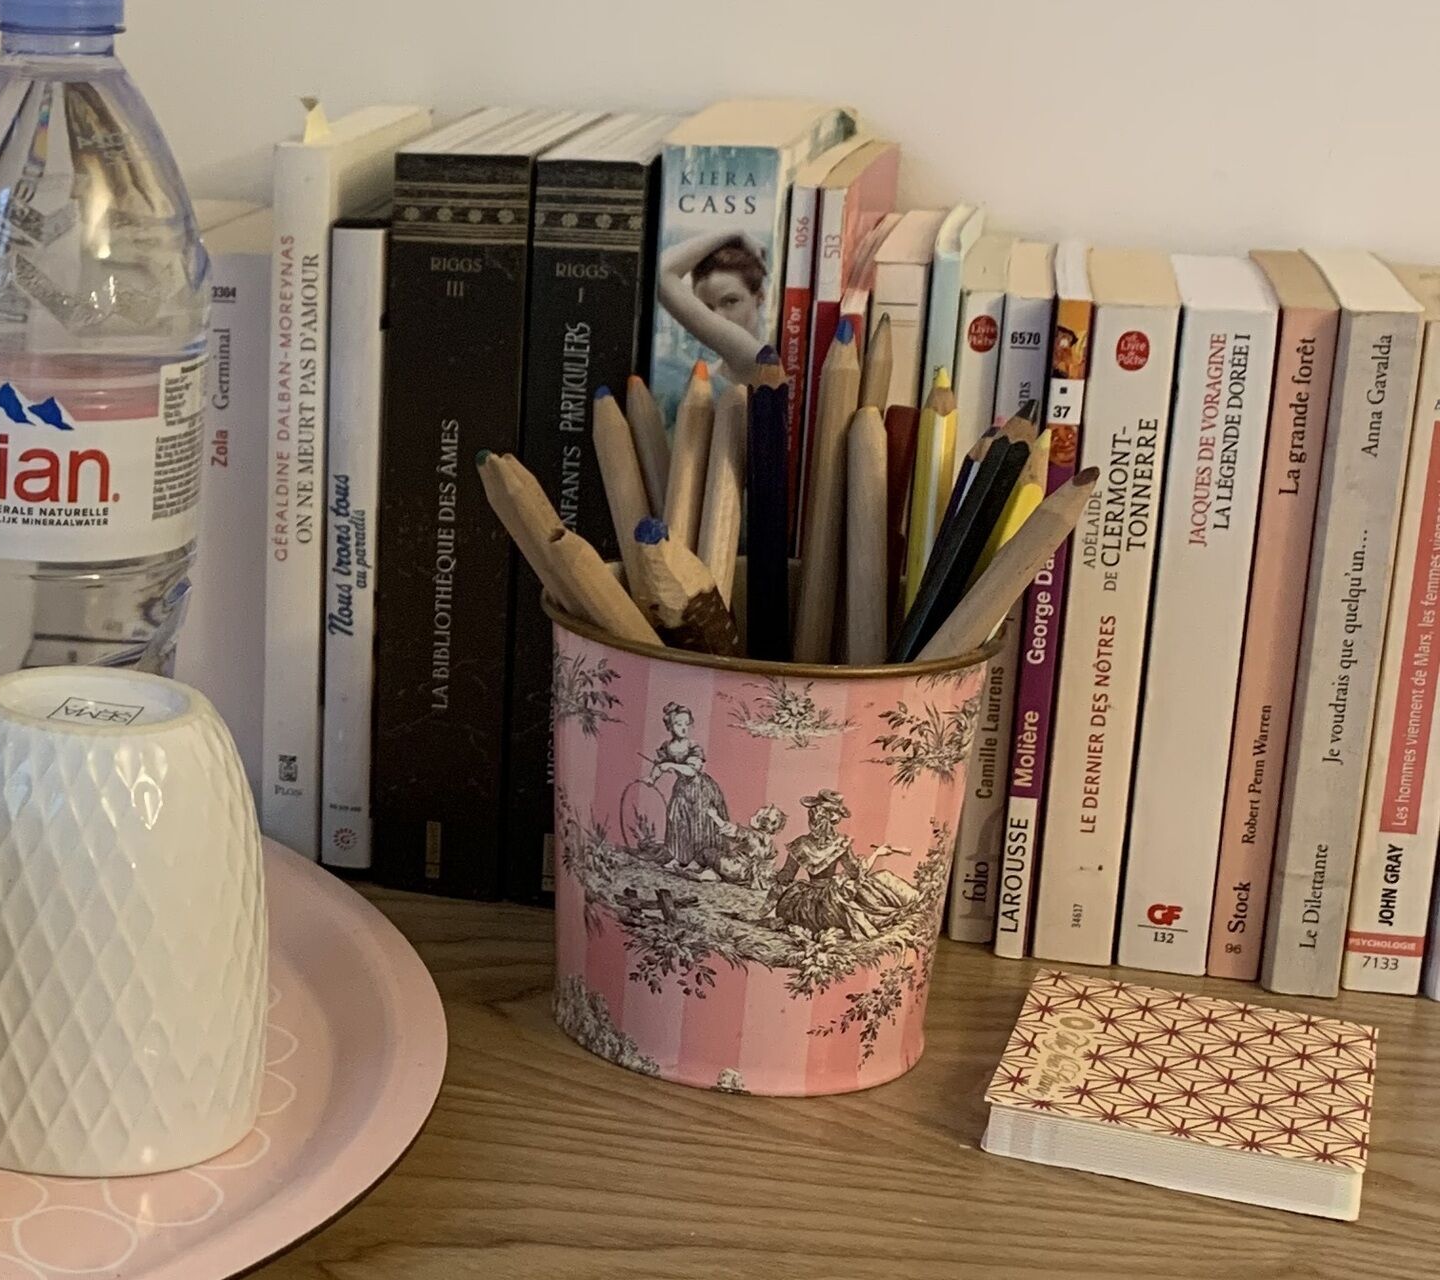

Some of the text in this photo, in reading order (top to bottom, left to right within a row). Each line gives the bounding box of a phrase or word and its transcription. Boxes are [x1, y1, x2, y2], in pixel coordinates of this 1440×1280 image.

[678, 194, 756, 214] CASS
[681, 171, 756, 187] KIERA
[795, 216, 810, 249] 1056
[824, 234, 841, 259] 513
[430, 256, 483, 273] RIGGS
[446, 280, 465, 297] III
[555, 262, 609, 279] RIGGS
[786, 306, 802, 334] d'or
[1010, 331, 1041, 345] 6570
[786, 337, 800, 371] yeux
[1227, 344, 1250, 410] DORÉE
[211, 327, 231, 468] Zola Germinal
[272, 234, 295, 562] GÉRALDINE DALBAN-MOREYNAS
[296, 253, 320, 544] ON NE MEURT PAS D'AMOUR
[1053, 406, 1071, 419] 37
[1278, 338, 1317, 496] La grande forêt
[1361, 334, 1393, 458] Anna Gavalda
[560, 321, 591, 533] NFANTS PARTICULIERS
[1188, 333, 1228, 548] JACQUES DE VORAGINE
[1214, 413, 1242, 502] LÉGENDE
[1101, 425, 1132, 592] DE CLERMONT-
[1125, 418, 1159, 552] TONNERRE
[21, 517, 109, 527] MINERAALWATER
[39, 506, 109, 517] NATURELLE
[1213, 506, 1232, 531] LA
[328, 473, 354, 637] Nous irons tous
[351, 509, 373, 589] au paradis
[431, 418, 460, 710] LA BIBLIOTHÈQUE DES ÂMES
[1420, 554, 1440, 606] femmes
[1026, 590, 1055, 665] George
[1417, 609, 1436, 628] les
[1340, 638, 1358, 670] que
[1414, 631, 1434, 668] Mars,
[1411, 670, 1428, 687] de
[975, 665, 1005, 801] Camille Laurens
[1080, 615, 1117, 834] LE DERNIER DES NÔTRES
[1329, 673, 1350, 744] voudrais
[1404, 688, 1426, 750] viennent
[1013, 710, 1040, 788] Molière
[1241, 704, 1272, 846] Robert Penn Warren
[1322, 748, 1344, 766] Je
[1395, 749, 1417, 804] hommes
[1392, 806, 1410, 827] Les
[962, 861, 990, 903] folio
[1000, 818, 1029, 933] LAROUSSE
[1299, 843, 1329, 950] Le Dilettante
[1378, 843, 1404, 927] JOHN GRAY
[1147, 903, 1183, 926] GF
[1227, 881, 1252, 934] Stock
[1153, 931, 1175, 944] 132
[1348, 938, 1416, 951] PSYCHOLOGIE
[1362, 955, 1399, 971] 7133
